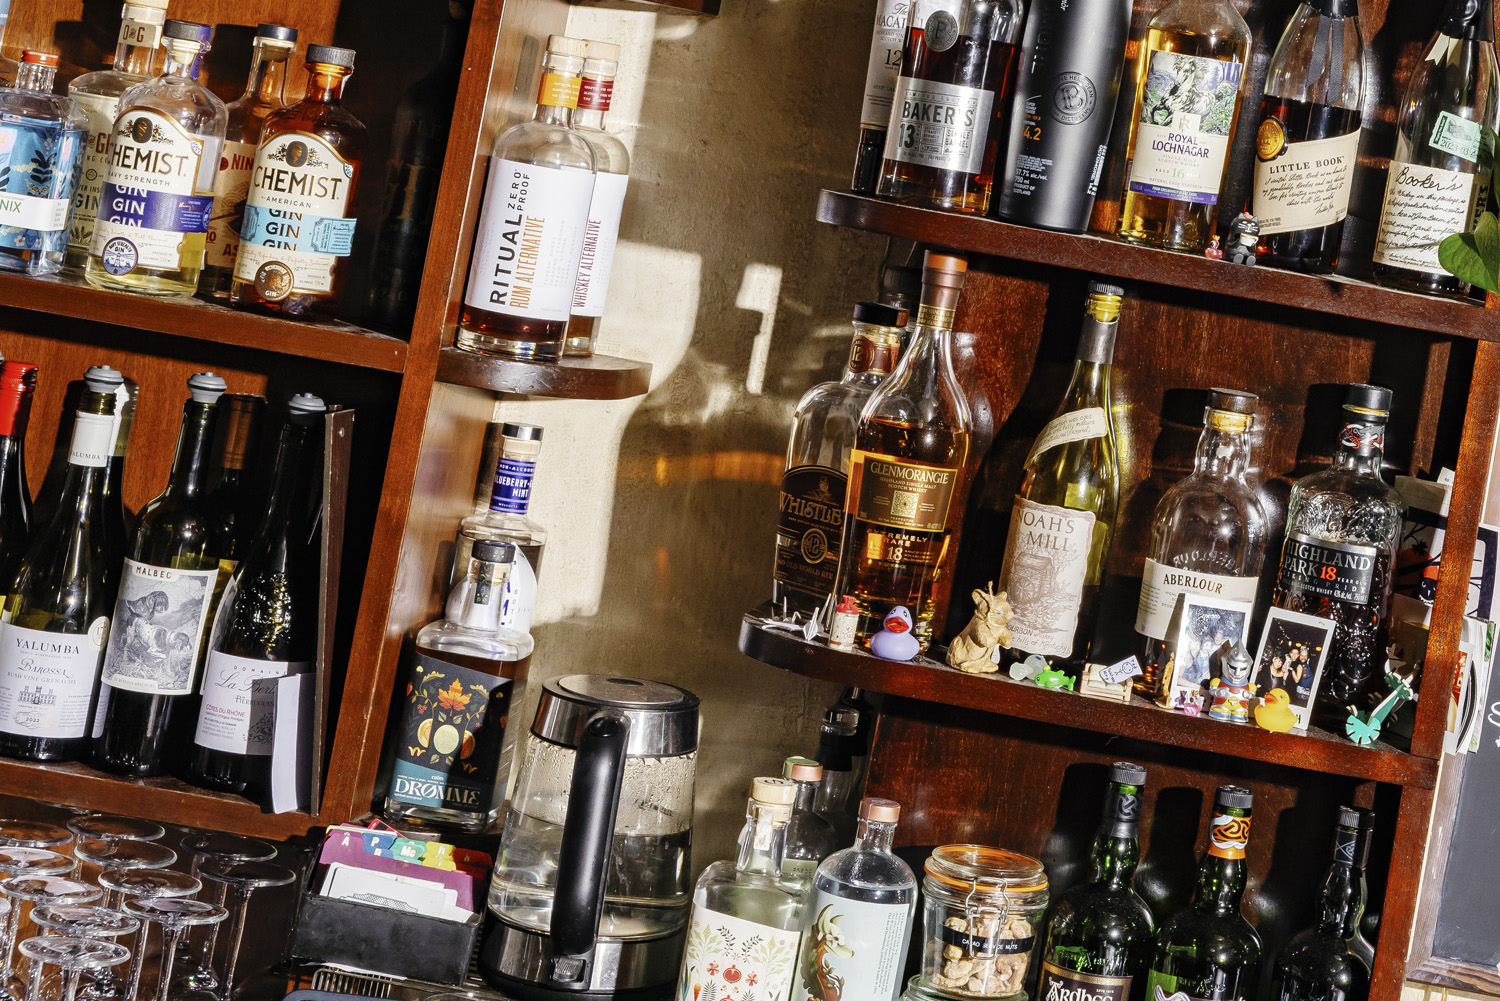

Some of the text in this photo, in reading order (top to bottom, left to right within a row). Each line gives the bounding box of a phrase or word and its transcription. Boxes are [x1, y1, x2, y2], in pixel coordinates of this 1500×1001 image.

[902, 100, 975, 128] BAKER'S
[1152, 140, 1210, 159] LOCHNAGAR
[1168, 132, 1199, 146] ROYAL
[112, 144, 190, 177] HEMIST
[1269, 156, 1343, 175] LITTLE BOOK
[124, 174, 171, 187] STRENGTH
[254, 165, 342, 200] CHEMIST
[1172, 167, 1185, 179] 16
[1395, 166, 1463, 191] Booker's
[507, 172, 520, 209] ZERO
[516, 173, 530, 212] PROOF
[113, 198, 146, 216] GIN
[266, 197, 312, 209] AMERICAN
[265, 222, 301, 239] GIN
[490, 214, 523, 306] RITUAL
[509, 214, 546, 309] RUM ALTERNATIVE
[572, 219, 602, 308] WHISKEY ALTERNATIVE
[870, 462, 949, 485] GLENMORANGIE
[512, 489, 529, 498] MINT
[1015, 508, 1075, 534] NOAH'S
[1026, 530, 1071, 552] MILL
[886, 547, 902, 561] 18
[1286, 540, 1371, 571] HIGHLAND
[135, 566, 173, 580] MALBEC
[1284, 556, 1337, 580] PARK 18
[1163, 573, 1223, 594] ABERLOUR
[16, 638, 80, 655] YALUMBA
